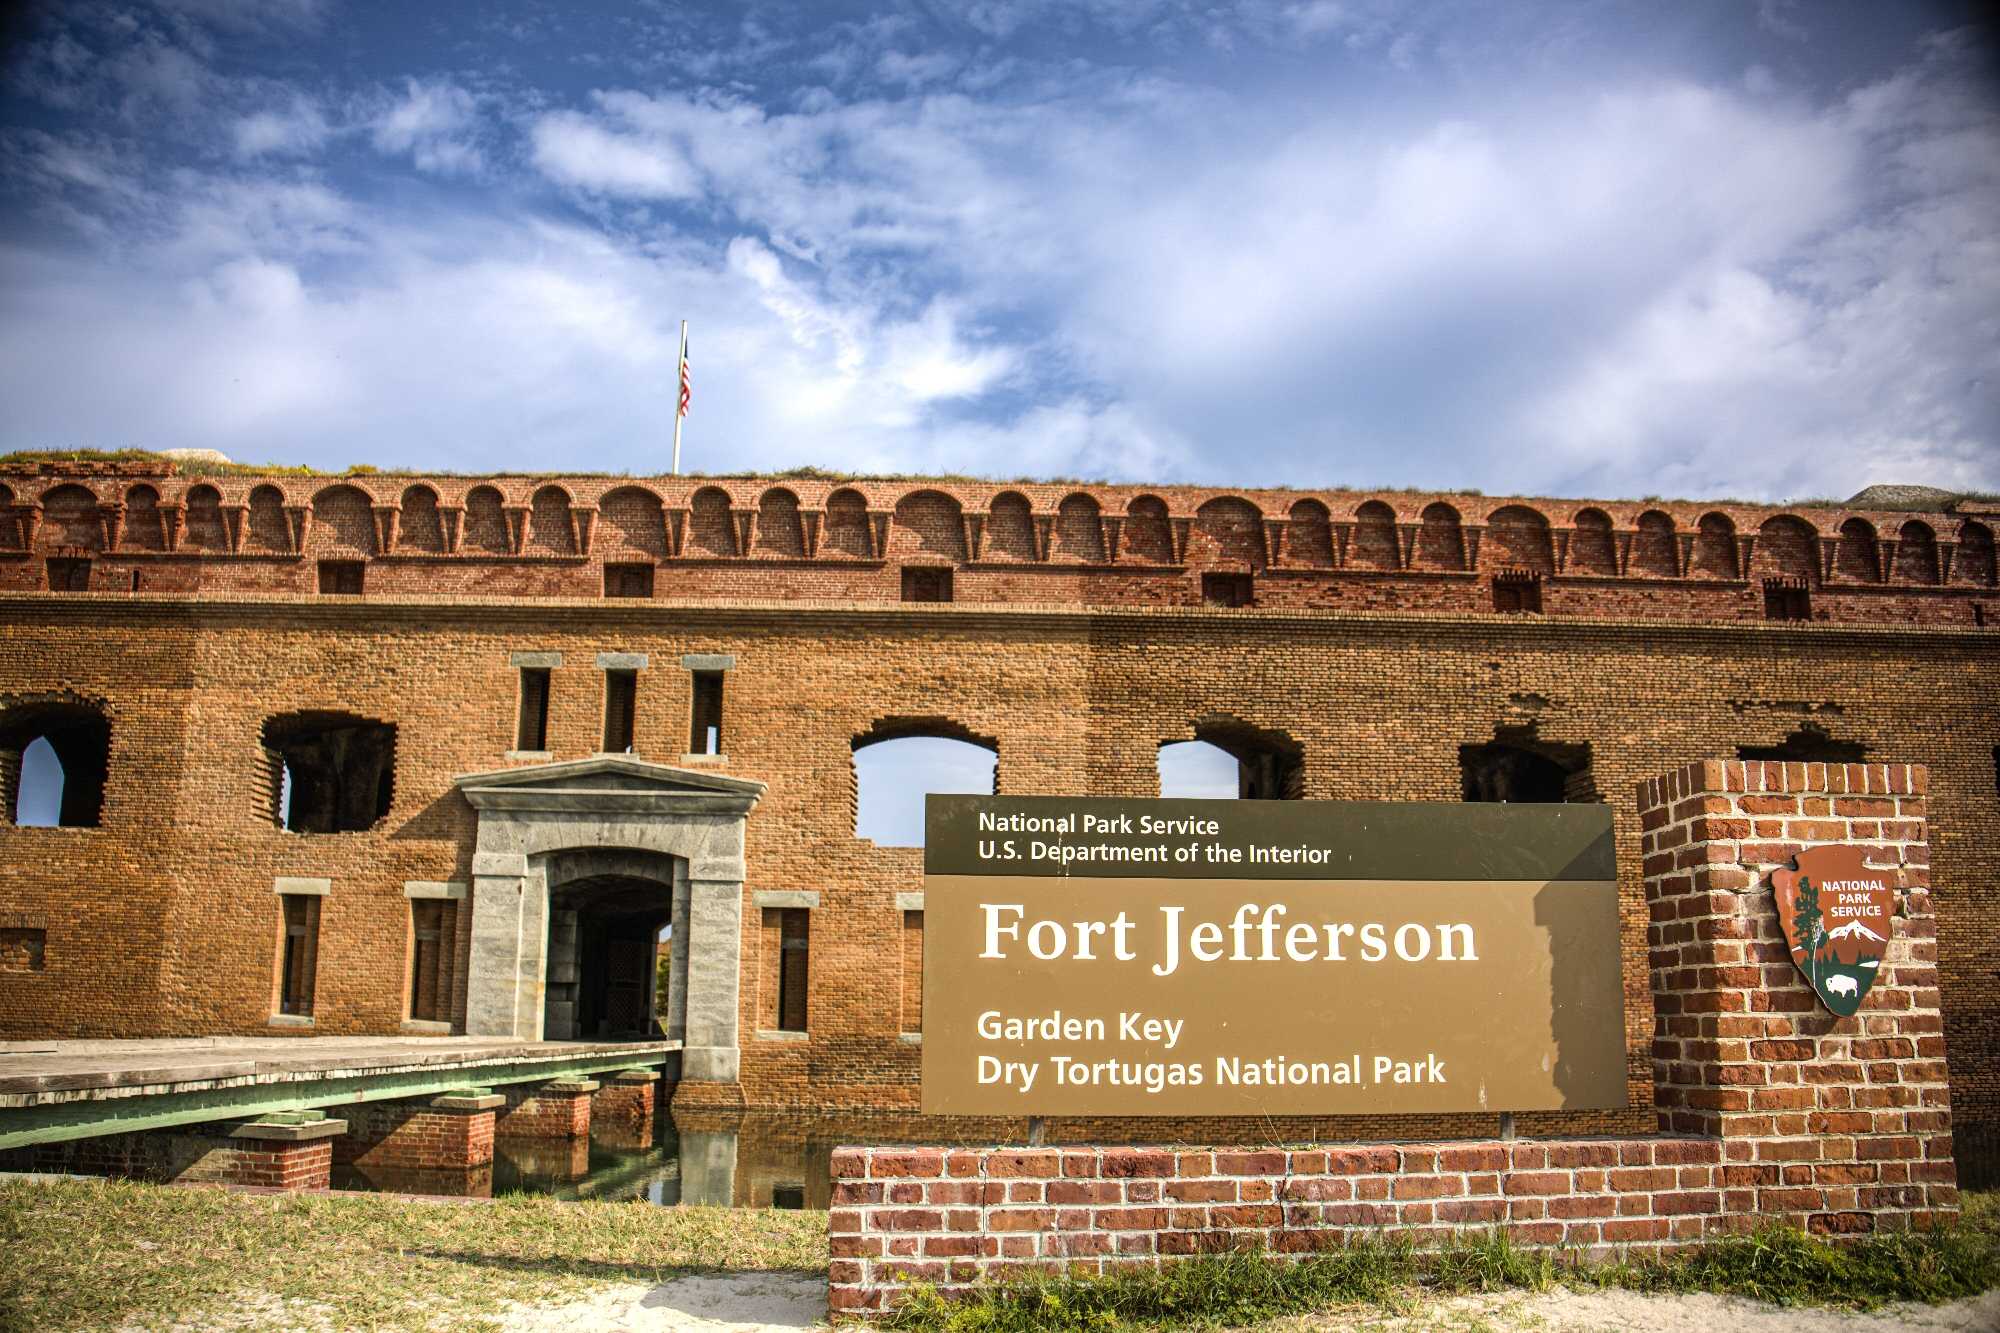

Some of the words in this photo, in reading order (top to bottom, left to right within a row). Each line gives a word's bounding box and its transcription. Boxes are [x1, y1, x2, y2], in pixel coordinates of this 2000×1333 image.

[980, 813, 1074, 833] National
[1084, 814, 1132, 833] Park
[1141, 816, 1219, 834] Service
[980, 841, 1022, 859] U.S.
[1031, 842, 1168, 864] Department
[1175, 843, 1198, 862] of
[1205, 843, 1242, 862] the
[1250, 845, 1331, 863] Interior
[1822, 880, 1885, 891] NATIONAL
[1839, 893, 1871, 903] PARK
[1831, 906, 1881, 916] SERVICE
[979, 904, 1136, 960] Fort
[1152, 904, 1479, 976] Jefferson
[978, 1011, 1104, 1040] Garden
[1120, 1013, 1183, 1048] Key
[979, 1056, 1039, 1092] Dry
[1051, 1057, 1203, 1092] Tortugas
[1217, 1055, 1360, 1084] National
[1375, 1054, 1446, 1083] Park
